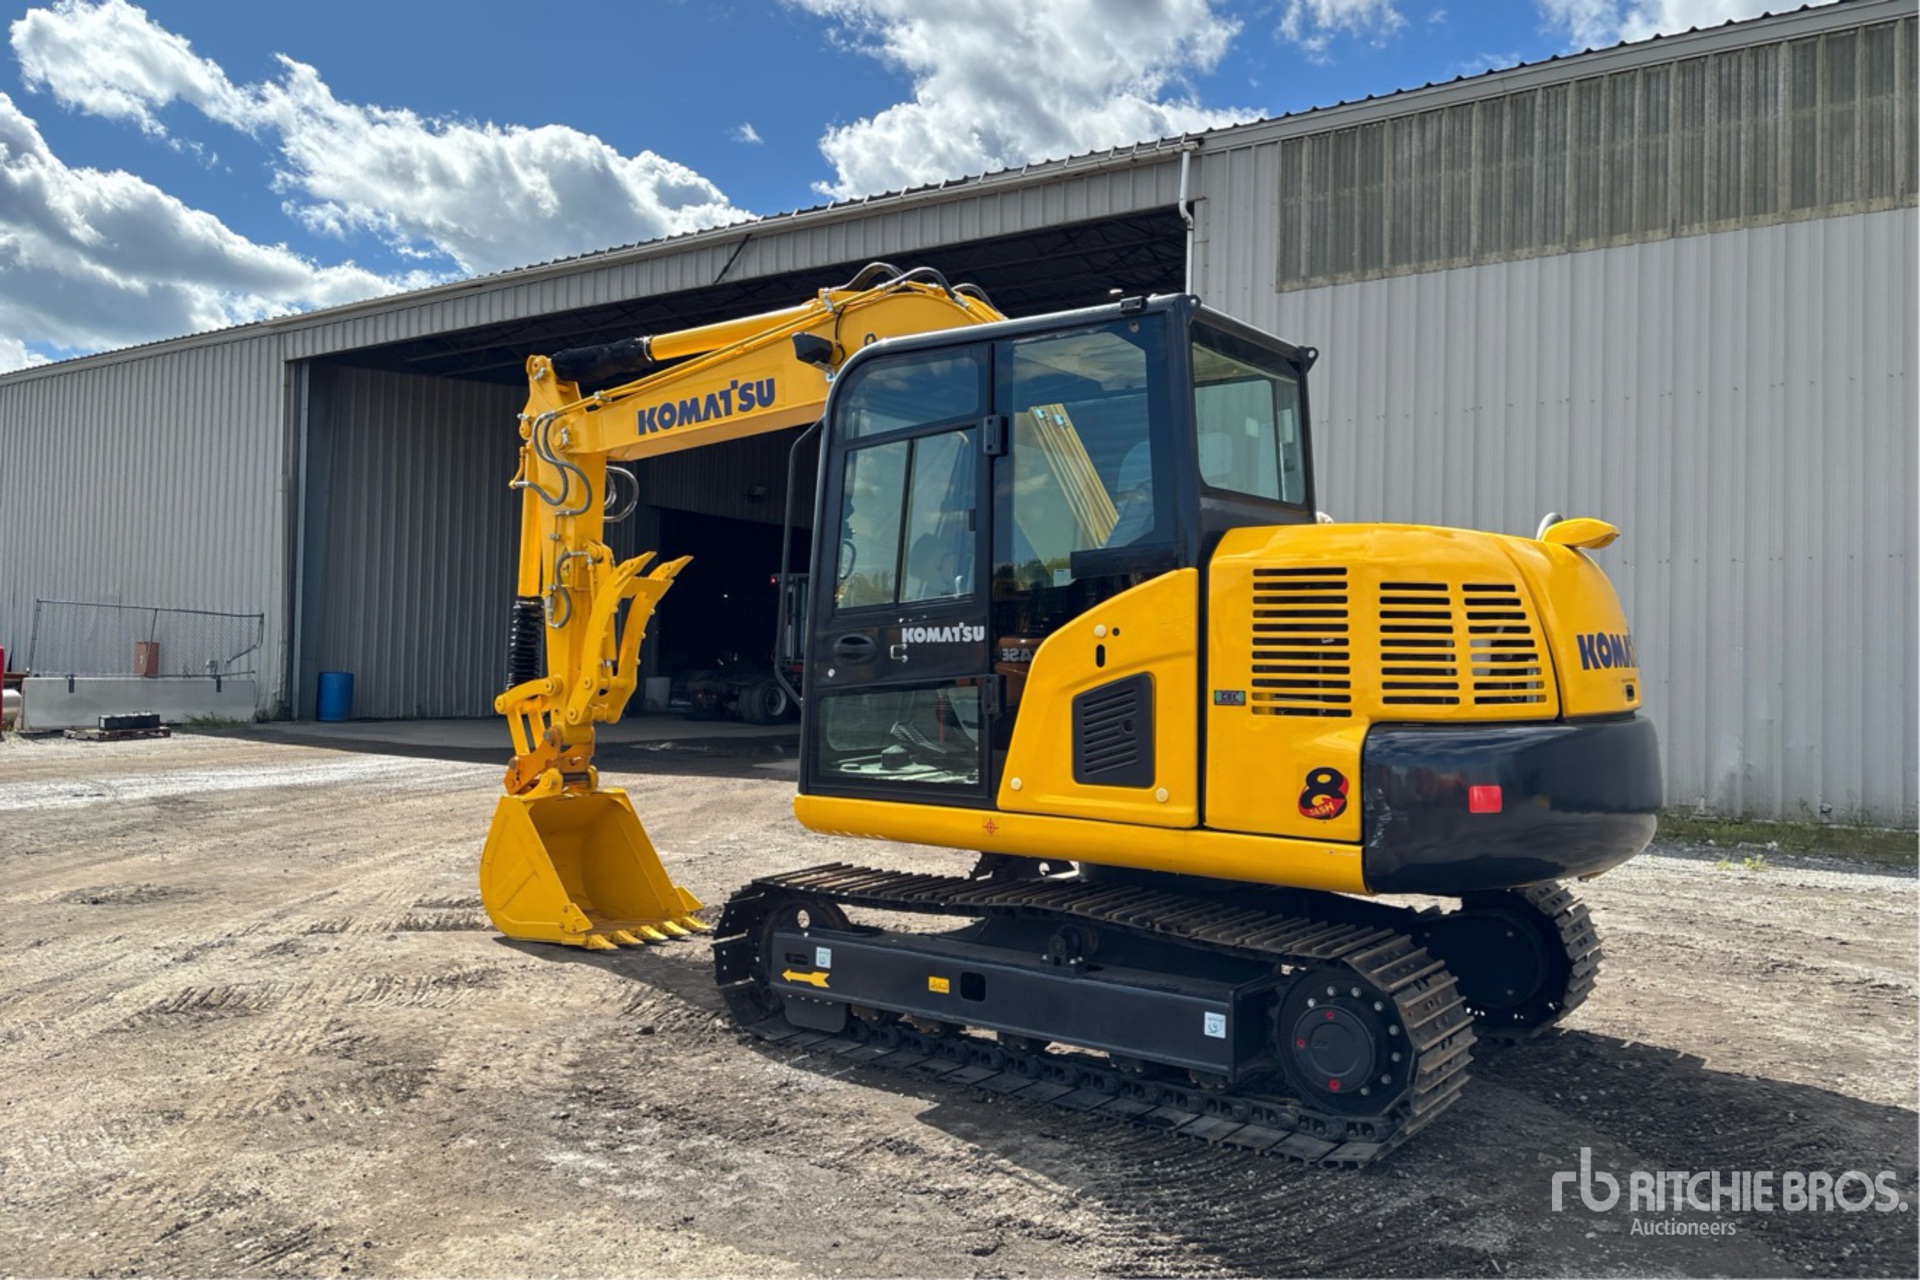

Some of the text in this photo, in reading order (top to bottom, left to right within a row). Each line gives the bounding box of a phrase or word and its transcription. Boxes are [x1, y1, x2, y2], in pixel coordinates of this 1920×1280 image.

[638, 377, 775, 435] KOMATSU
[901, 622, 984, 643] KOMATSU
[1299, 767, 1349, 819] 8
